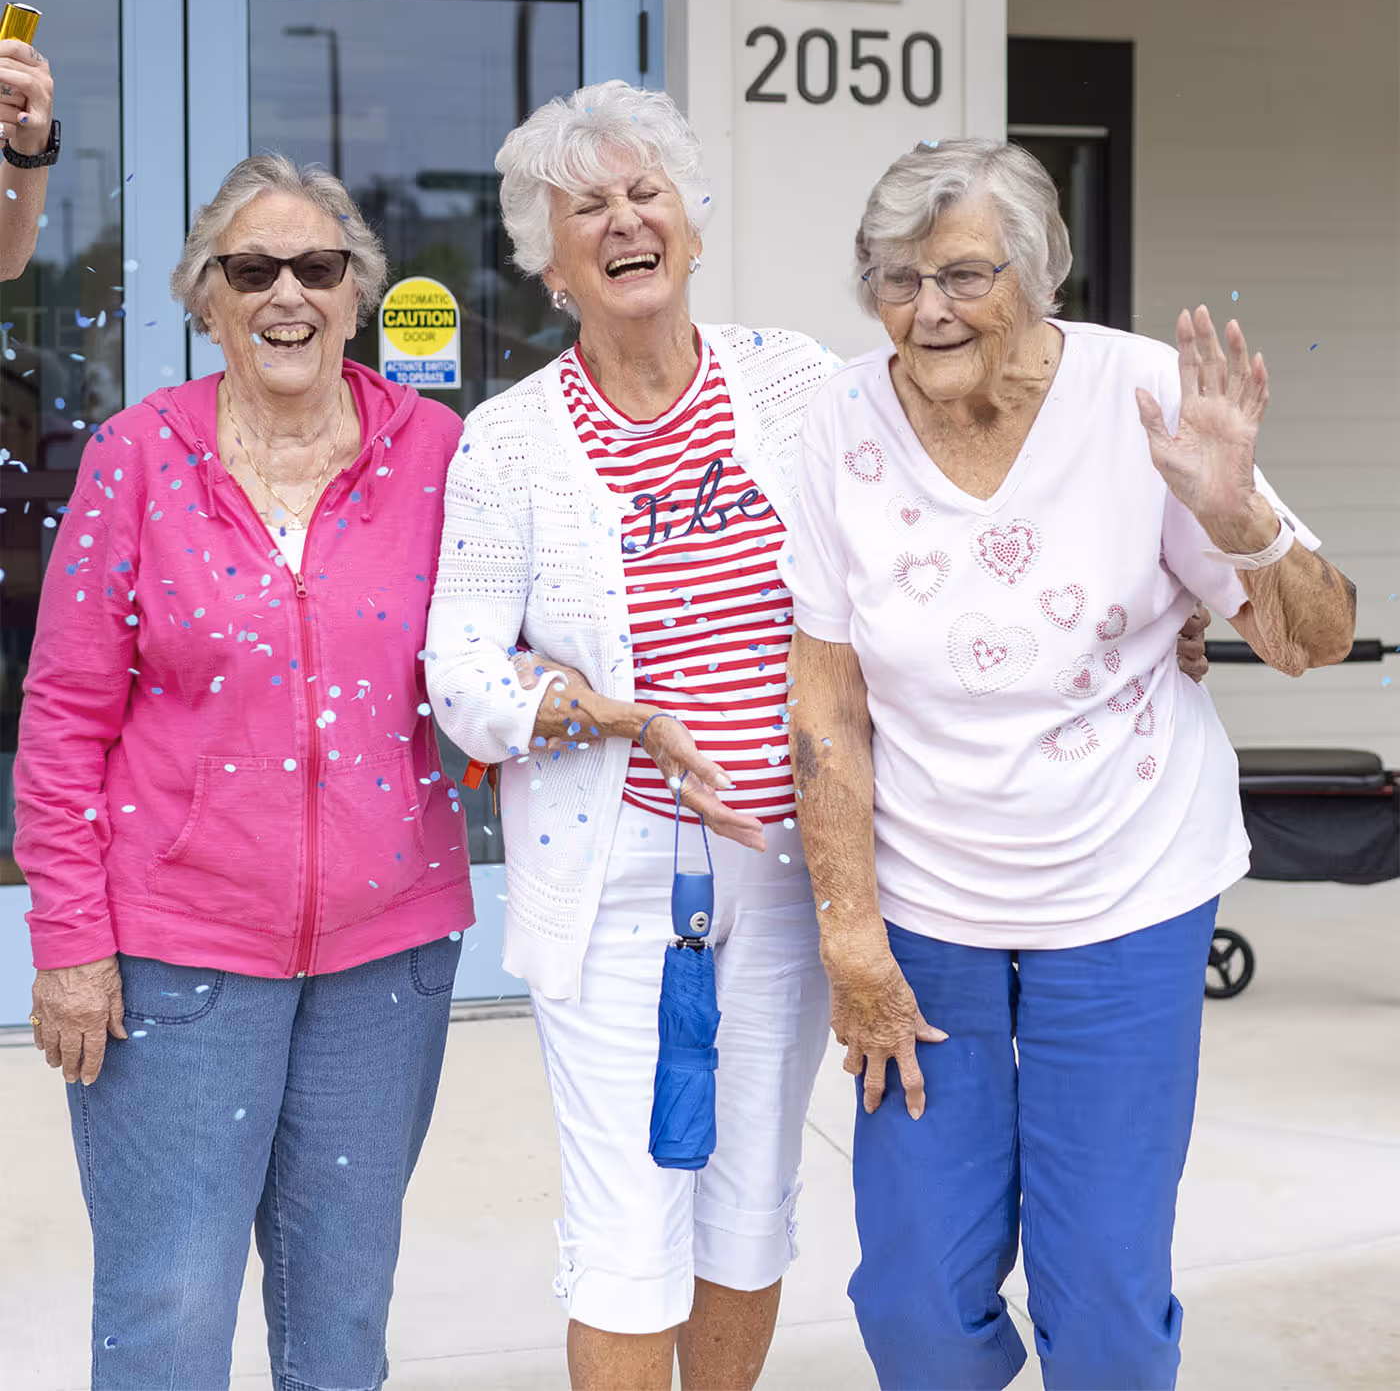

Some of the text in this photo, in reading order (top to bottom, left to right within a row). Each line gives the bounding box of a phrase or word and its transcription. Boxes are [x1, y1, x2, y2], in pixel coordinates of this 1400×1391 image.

[745, 26, 942, 107] 2050
[389, 293, 449, 305] AUTOMATIC
[384, 310, 454, 326] CAUTION
[403, 331, 435, 342] DOOR
[387, 361, 456, 371] ACTIVATE SWITCH
[397, 371, 445, 382] TO OPERATE
